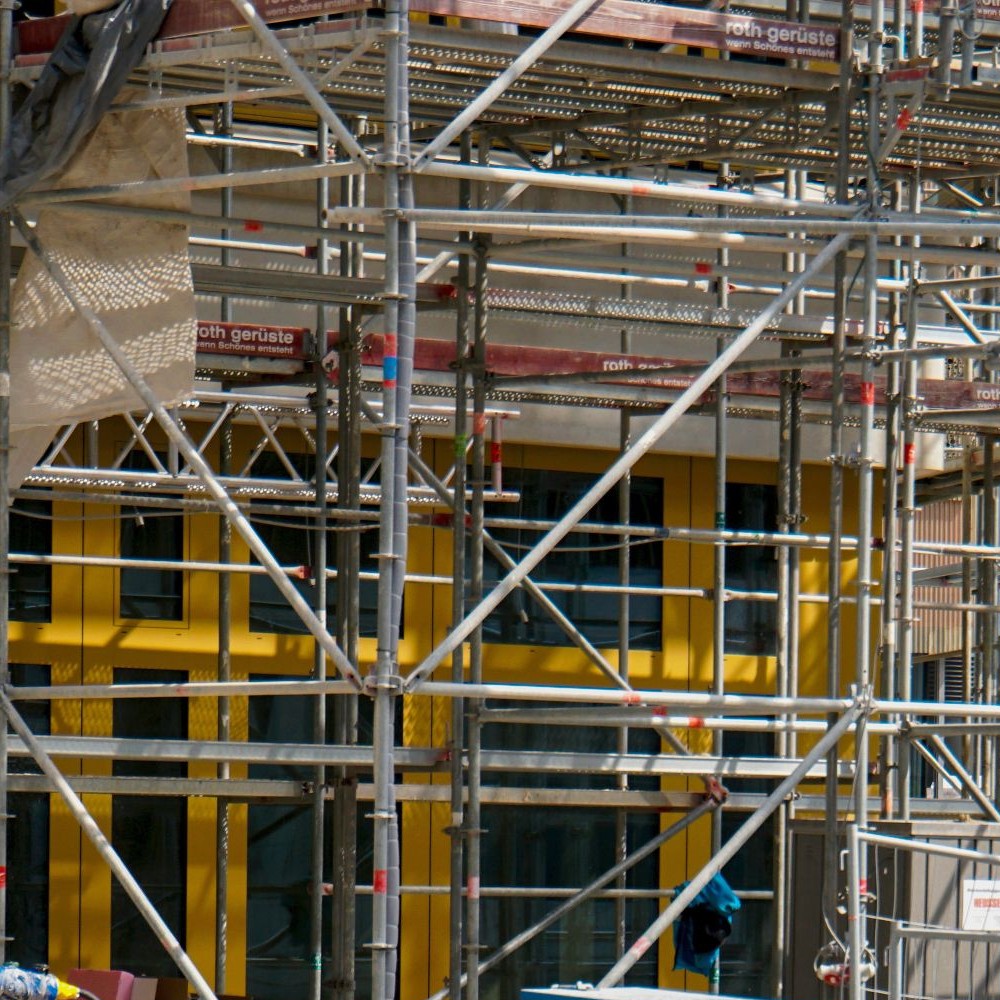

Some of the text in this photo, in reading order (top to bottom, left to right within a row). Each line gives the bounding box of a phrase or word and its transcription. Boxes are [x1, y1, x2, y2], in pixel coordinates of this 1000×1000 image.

[725, 21, 836, 47] roth gerüste
[725, 39, 836, 59] wenn Schönes entsteht
[231, 327, 294, 344] gerüste
[218, 341, 256, 352] Schönes
[258, 345, 293, 355] entsteht
[603, 359, 633, 372] roth
